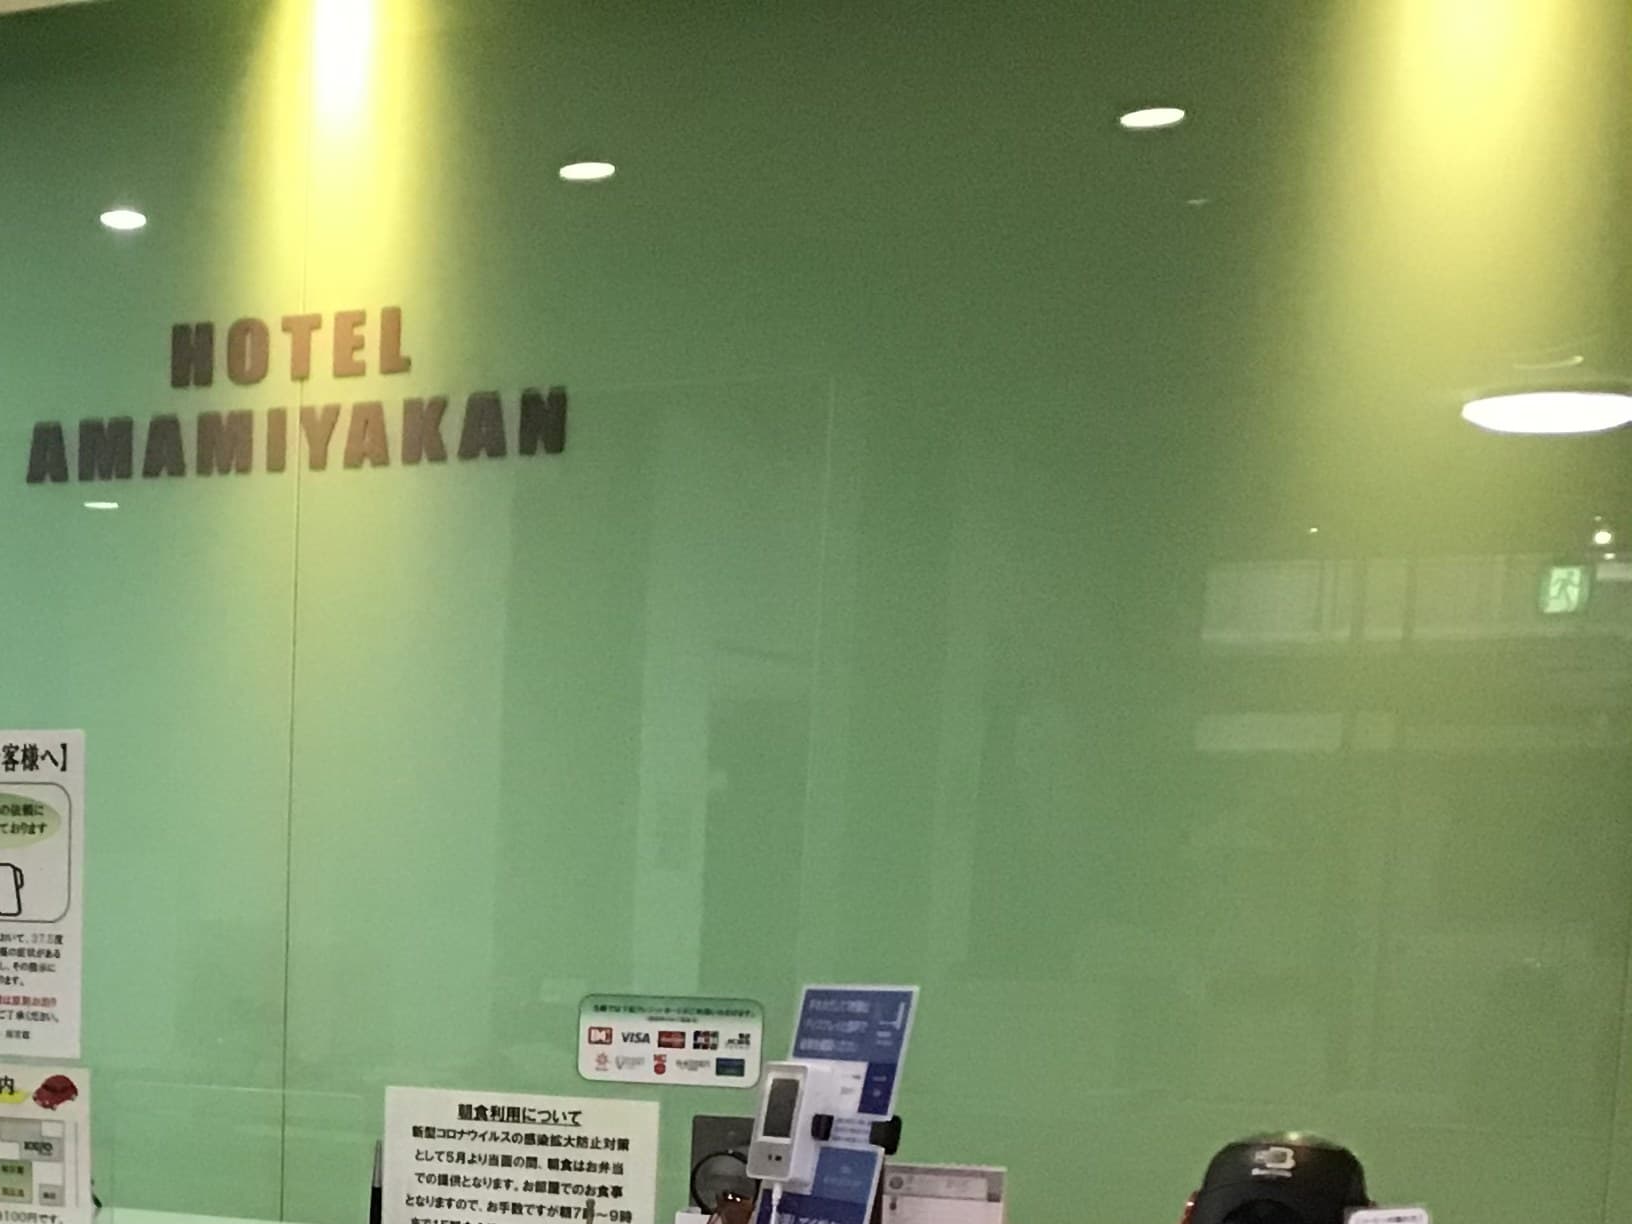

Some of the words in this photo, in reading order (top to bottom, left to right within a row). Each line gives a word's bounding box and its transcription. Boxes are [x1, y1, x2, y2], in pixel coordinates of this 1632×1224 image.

[171, 306, 411, 388] HOTEL
[27, 386, 568, 483] AMAMIYAKAN
[621, 1032, 651, 1044] VISA
[457, 1103, 583, 1127] 朝食利用について
[412, 1125, 630, 1152] 新型コロナウイルスの感染拡大防止対策
